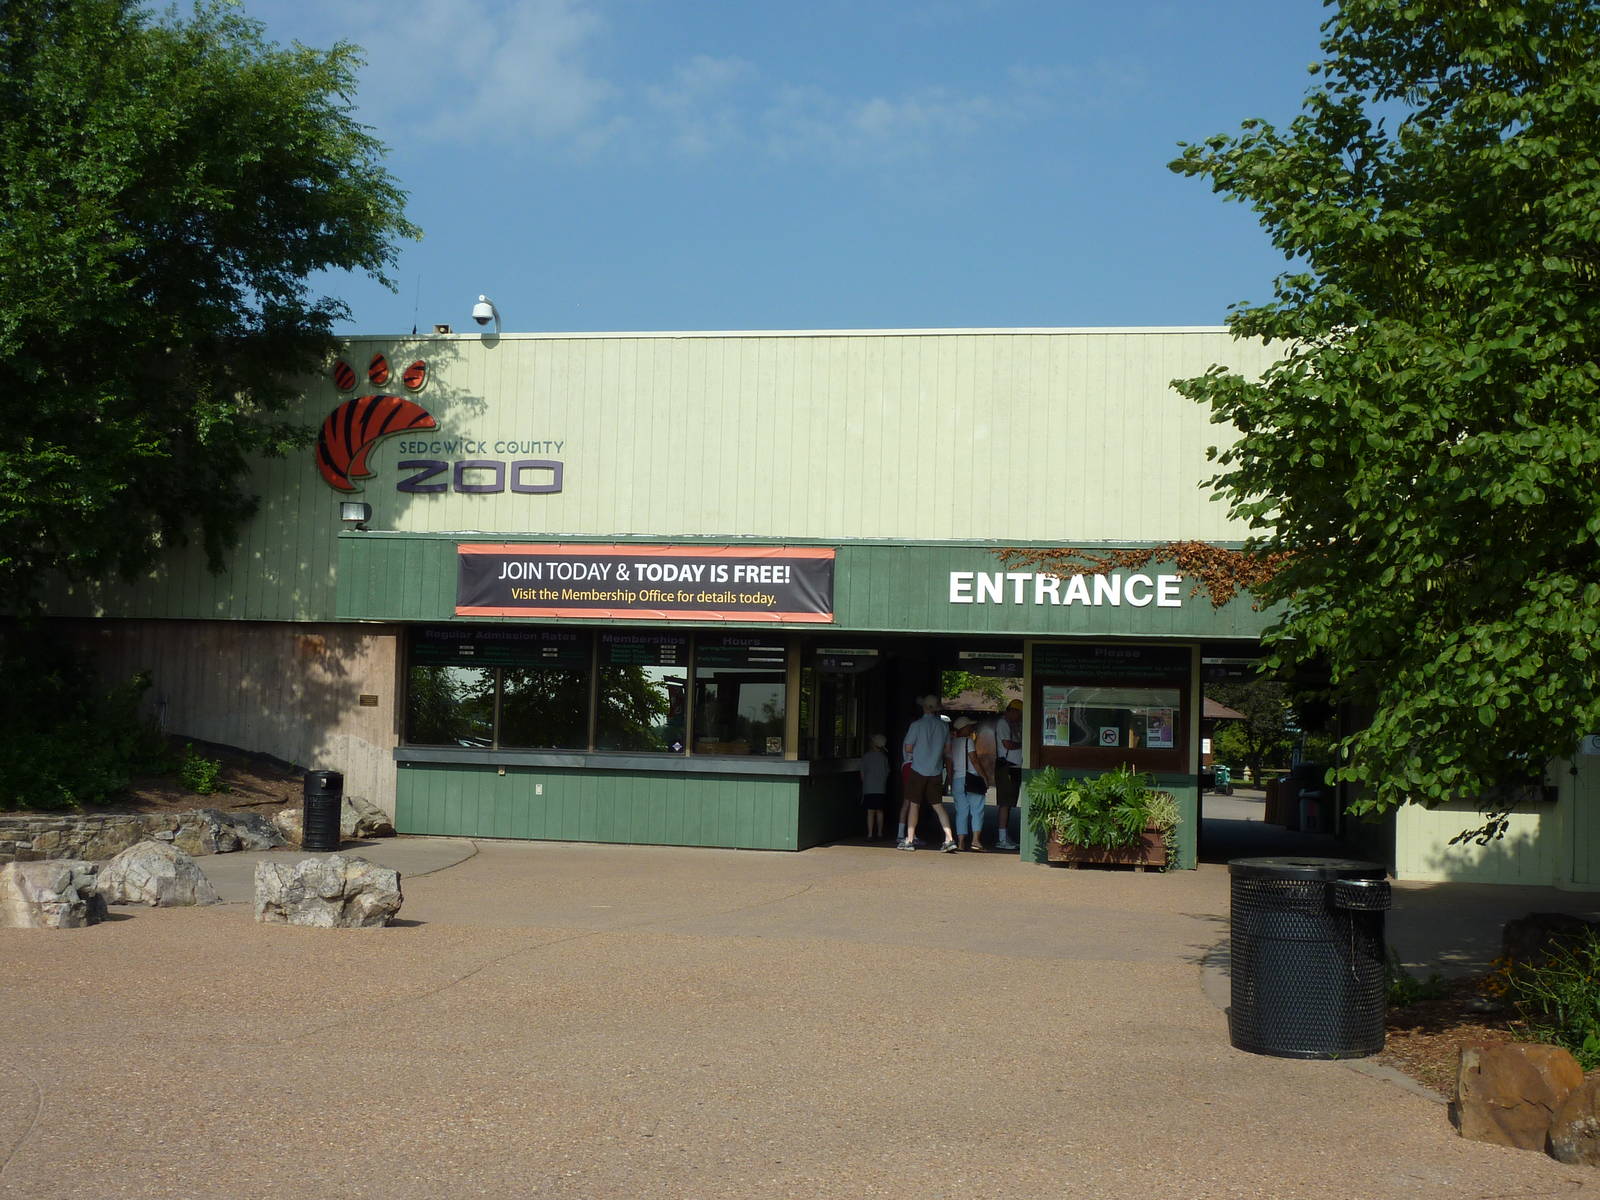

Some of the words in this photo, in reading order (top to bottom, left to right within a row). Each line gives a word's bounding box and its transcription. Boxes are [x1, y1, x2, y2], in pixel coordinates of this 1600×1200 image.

[400, 436, 487, 454] SEDGWICK
[494, 441, 564, 454] COUNTY
[396, 459, 563, 494] ZOO
[498, 562, 542, 580] JOIN
[546, 562, 612, 581] TODAY
[616, 563, 630, 581] &
[634, 563, 706, 582] TODAY
[710, 564, 729, 583] IS
[734, 565, 791, 584] FREE!
[511, 588, 537, 600] Visit
[539, 588, 559, 601] the
[561, 588, 636, 604] Membership
[639, 590, 674, 602] Office
[677, 590, 695, 603] for
[697, 591, 736, 604] details
[739, 592, 777, 607] today.
[949, 571, 1182, 608] ENTRANCE
